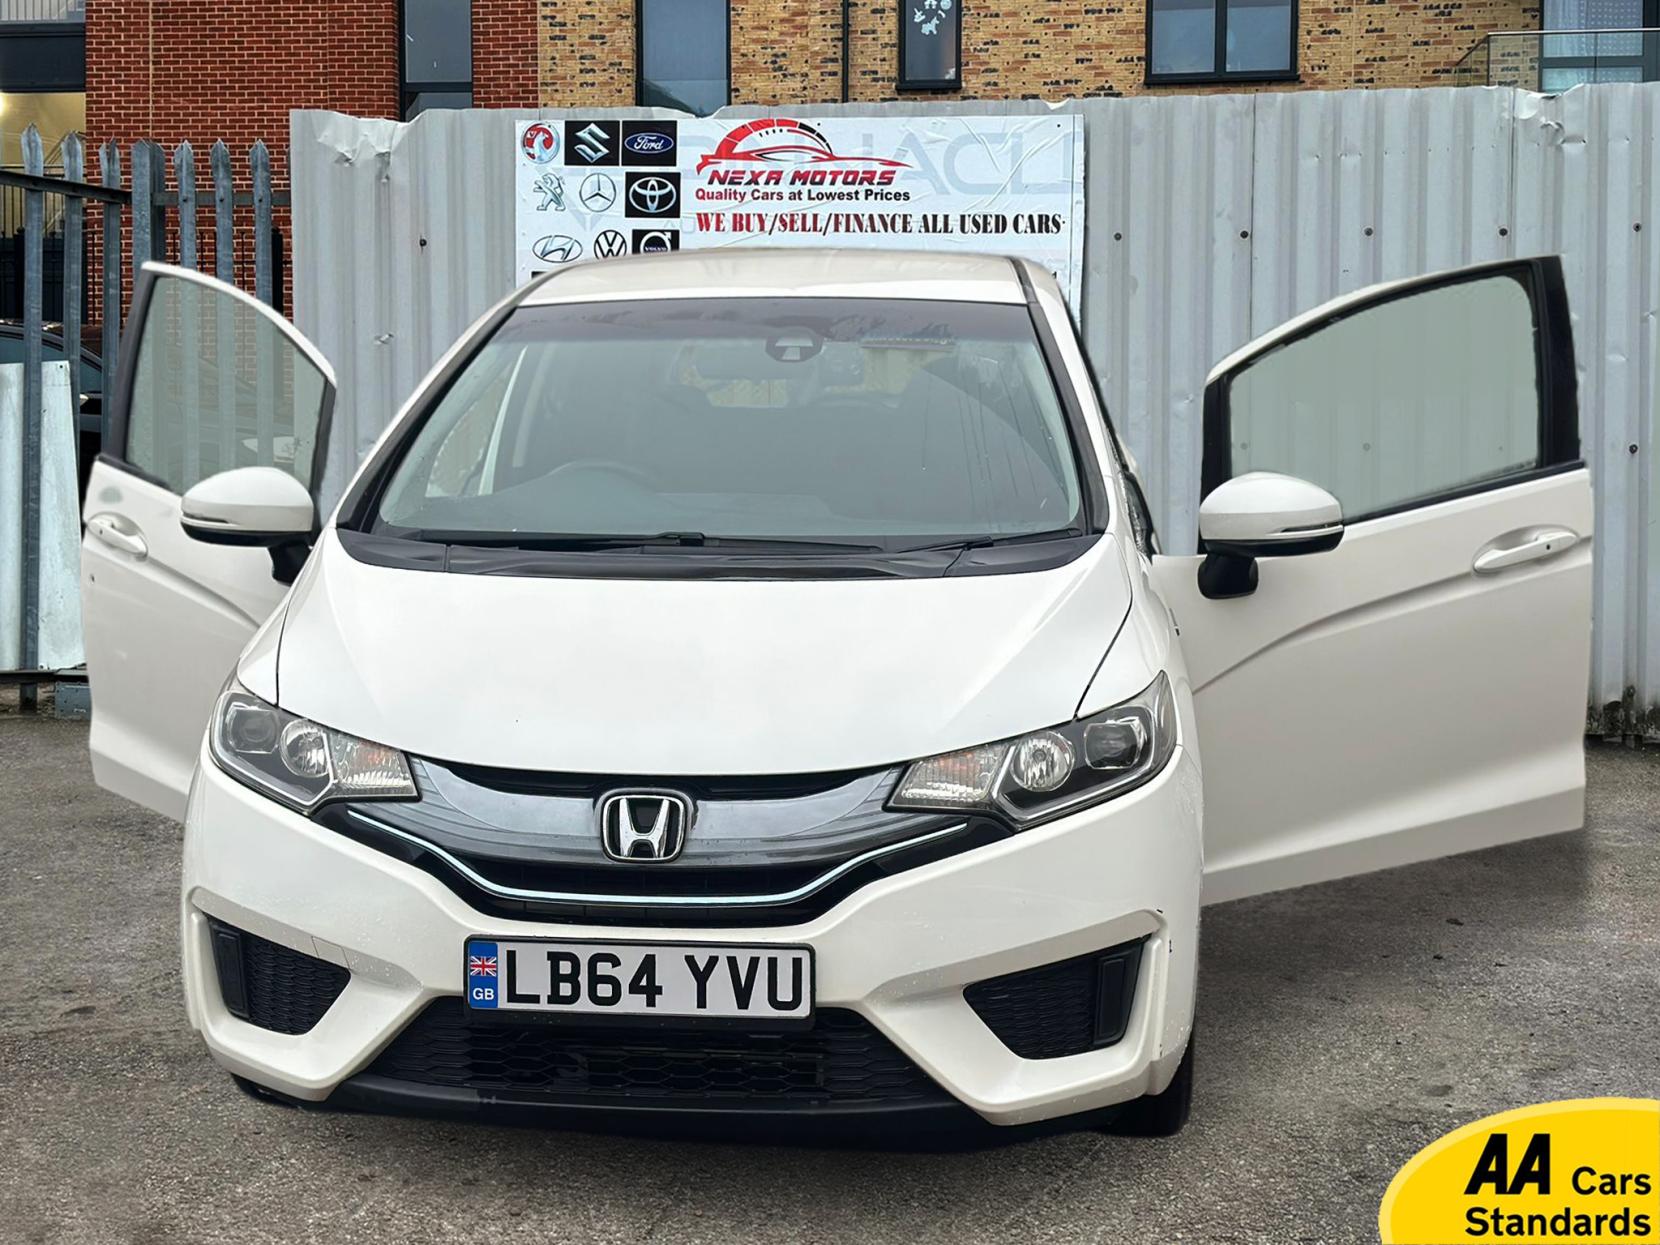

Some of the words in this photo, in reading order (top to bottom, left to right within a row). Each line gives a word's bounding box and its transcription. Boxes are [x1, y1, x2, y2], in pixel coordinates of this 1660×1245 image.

[633, 136, 664, 150] Ford
[708, 169, 782, 186] NEXA
[789, 169, 897, 186] MOTORS
[695, 187, 747, 203] Quality
[751, 188, 784, 201] Cars
[788, 189, 803, 201] at
[808, 188, 860, 201] Lowest
[865, 188, 911, 202] Prices
[696, 212, 726, 233] WE
[731, 212, 913, 236] BUY/SELL/FINANCE
[917, 213, 954, 234] ALL
[959, 213, 1008, 235] USED
[1012, 213, 1062, 235] CARS
[506, 949, 663, 1009] LB64
[684, 954, 803, 1011] YVU
[472, 987, 495, 1001] GB
